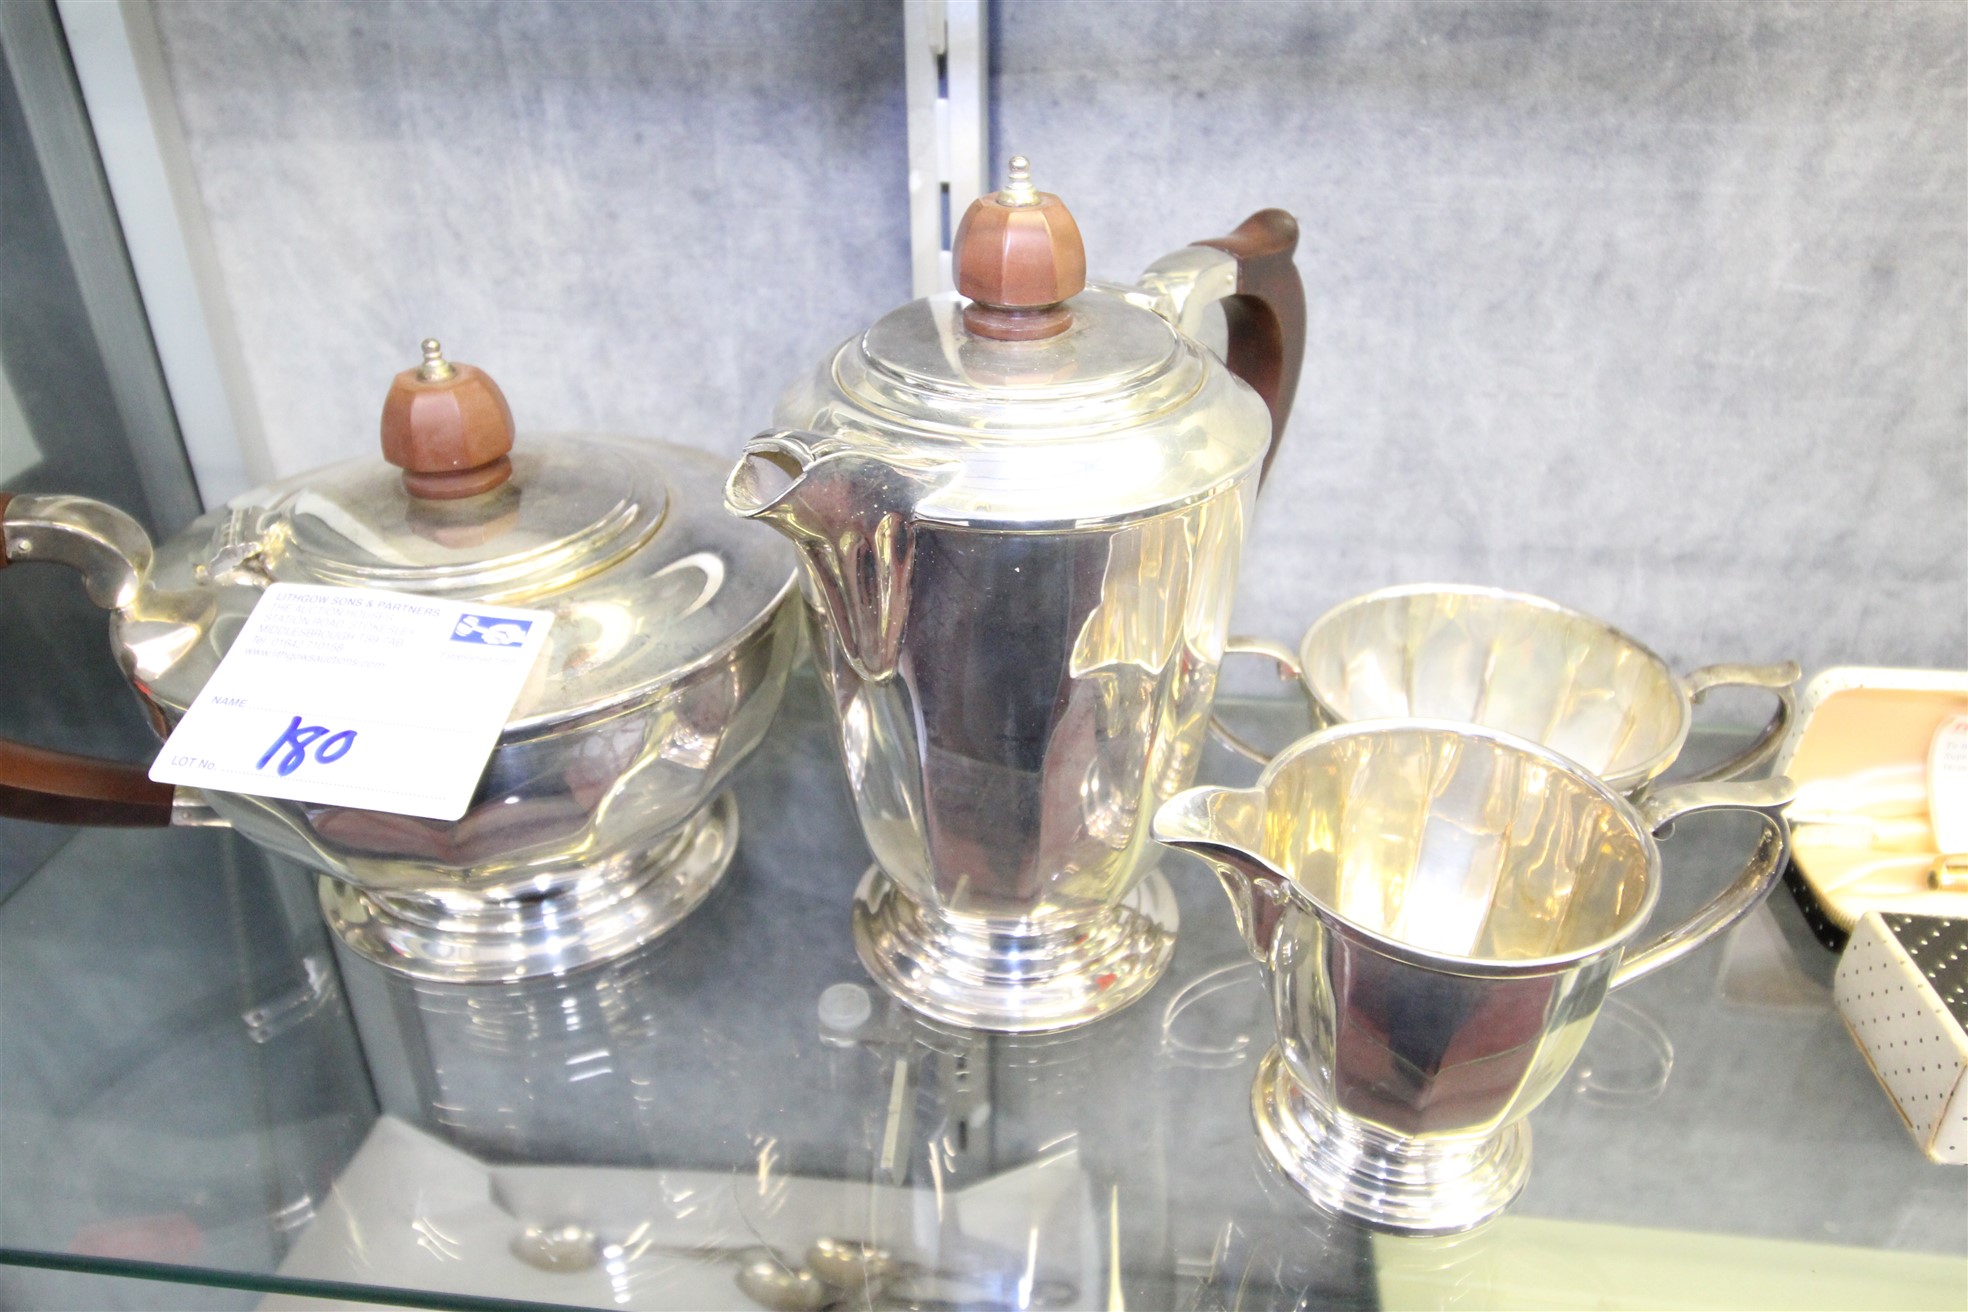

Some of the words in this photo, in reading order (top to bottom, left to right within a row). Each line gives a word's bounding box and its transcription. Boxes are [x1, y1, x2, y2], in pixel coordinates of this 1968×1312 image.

[271, 602, 290, 612] THE
[275, 592, 329, 604] LITHGOW
[330, 596, 363, 607] SONS
[365, 599, 374, 608] &
[377, 600, 441, 617] PARTNERS
[263, 613, 310, 626] STATION
[257, 624, 355, 641] MIDDLESBROUGH
[211, 696, 249, 708] NAME
[255, 715, 358, 777] 180
[171, 755, 198, 768] LOT
